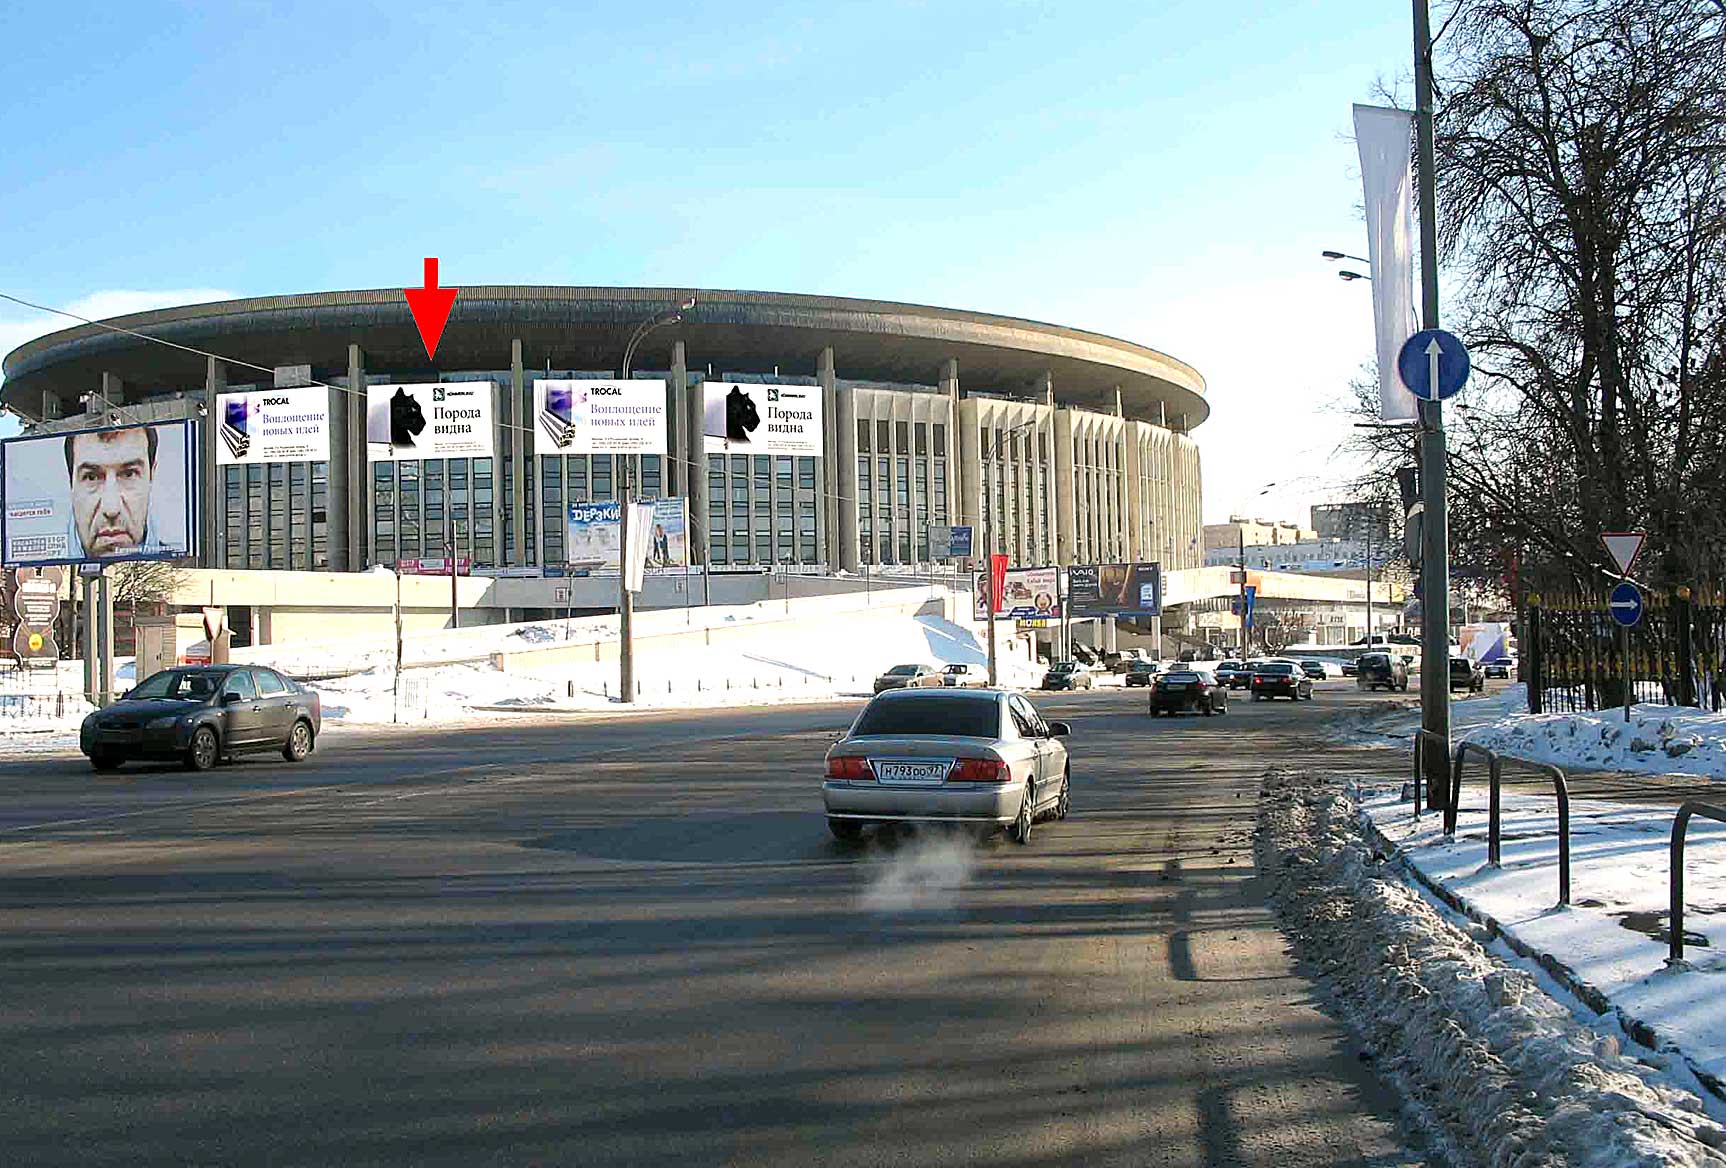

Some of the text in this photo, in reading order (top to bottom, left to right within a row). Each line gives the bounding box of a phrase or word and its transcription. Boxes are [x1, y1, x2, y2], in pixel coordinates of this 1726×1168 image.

[591, 387, 622, 396] TROCAL
[263, 397, 290, 406] TROCAL
[434, 406, 481, 422] Порода
[591, 403, 662, 416] Воплощение
[768, 406, 813, 422] Порода
[263, 413, 325, 424] Воплощение
[591, 416, 656, 426] новых идей
[263, 424, 320, 436] новых идей
[434, 424, 472, 435] видна
[768, 423, 804, 434] видна
[572, 505, 621, 522] ДЕРЗКИ
